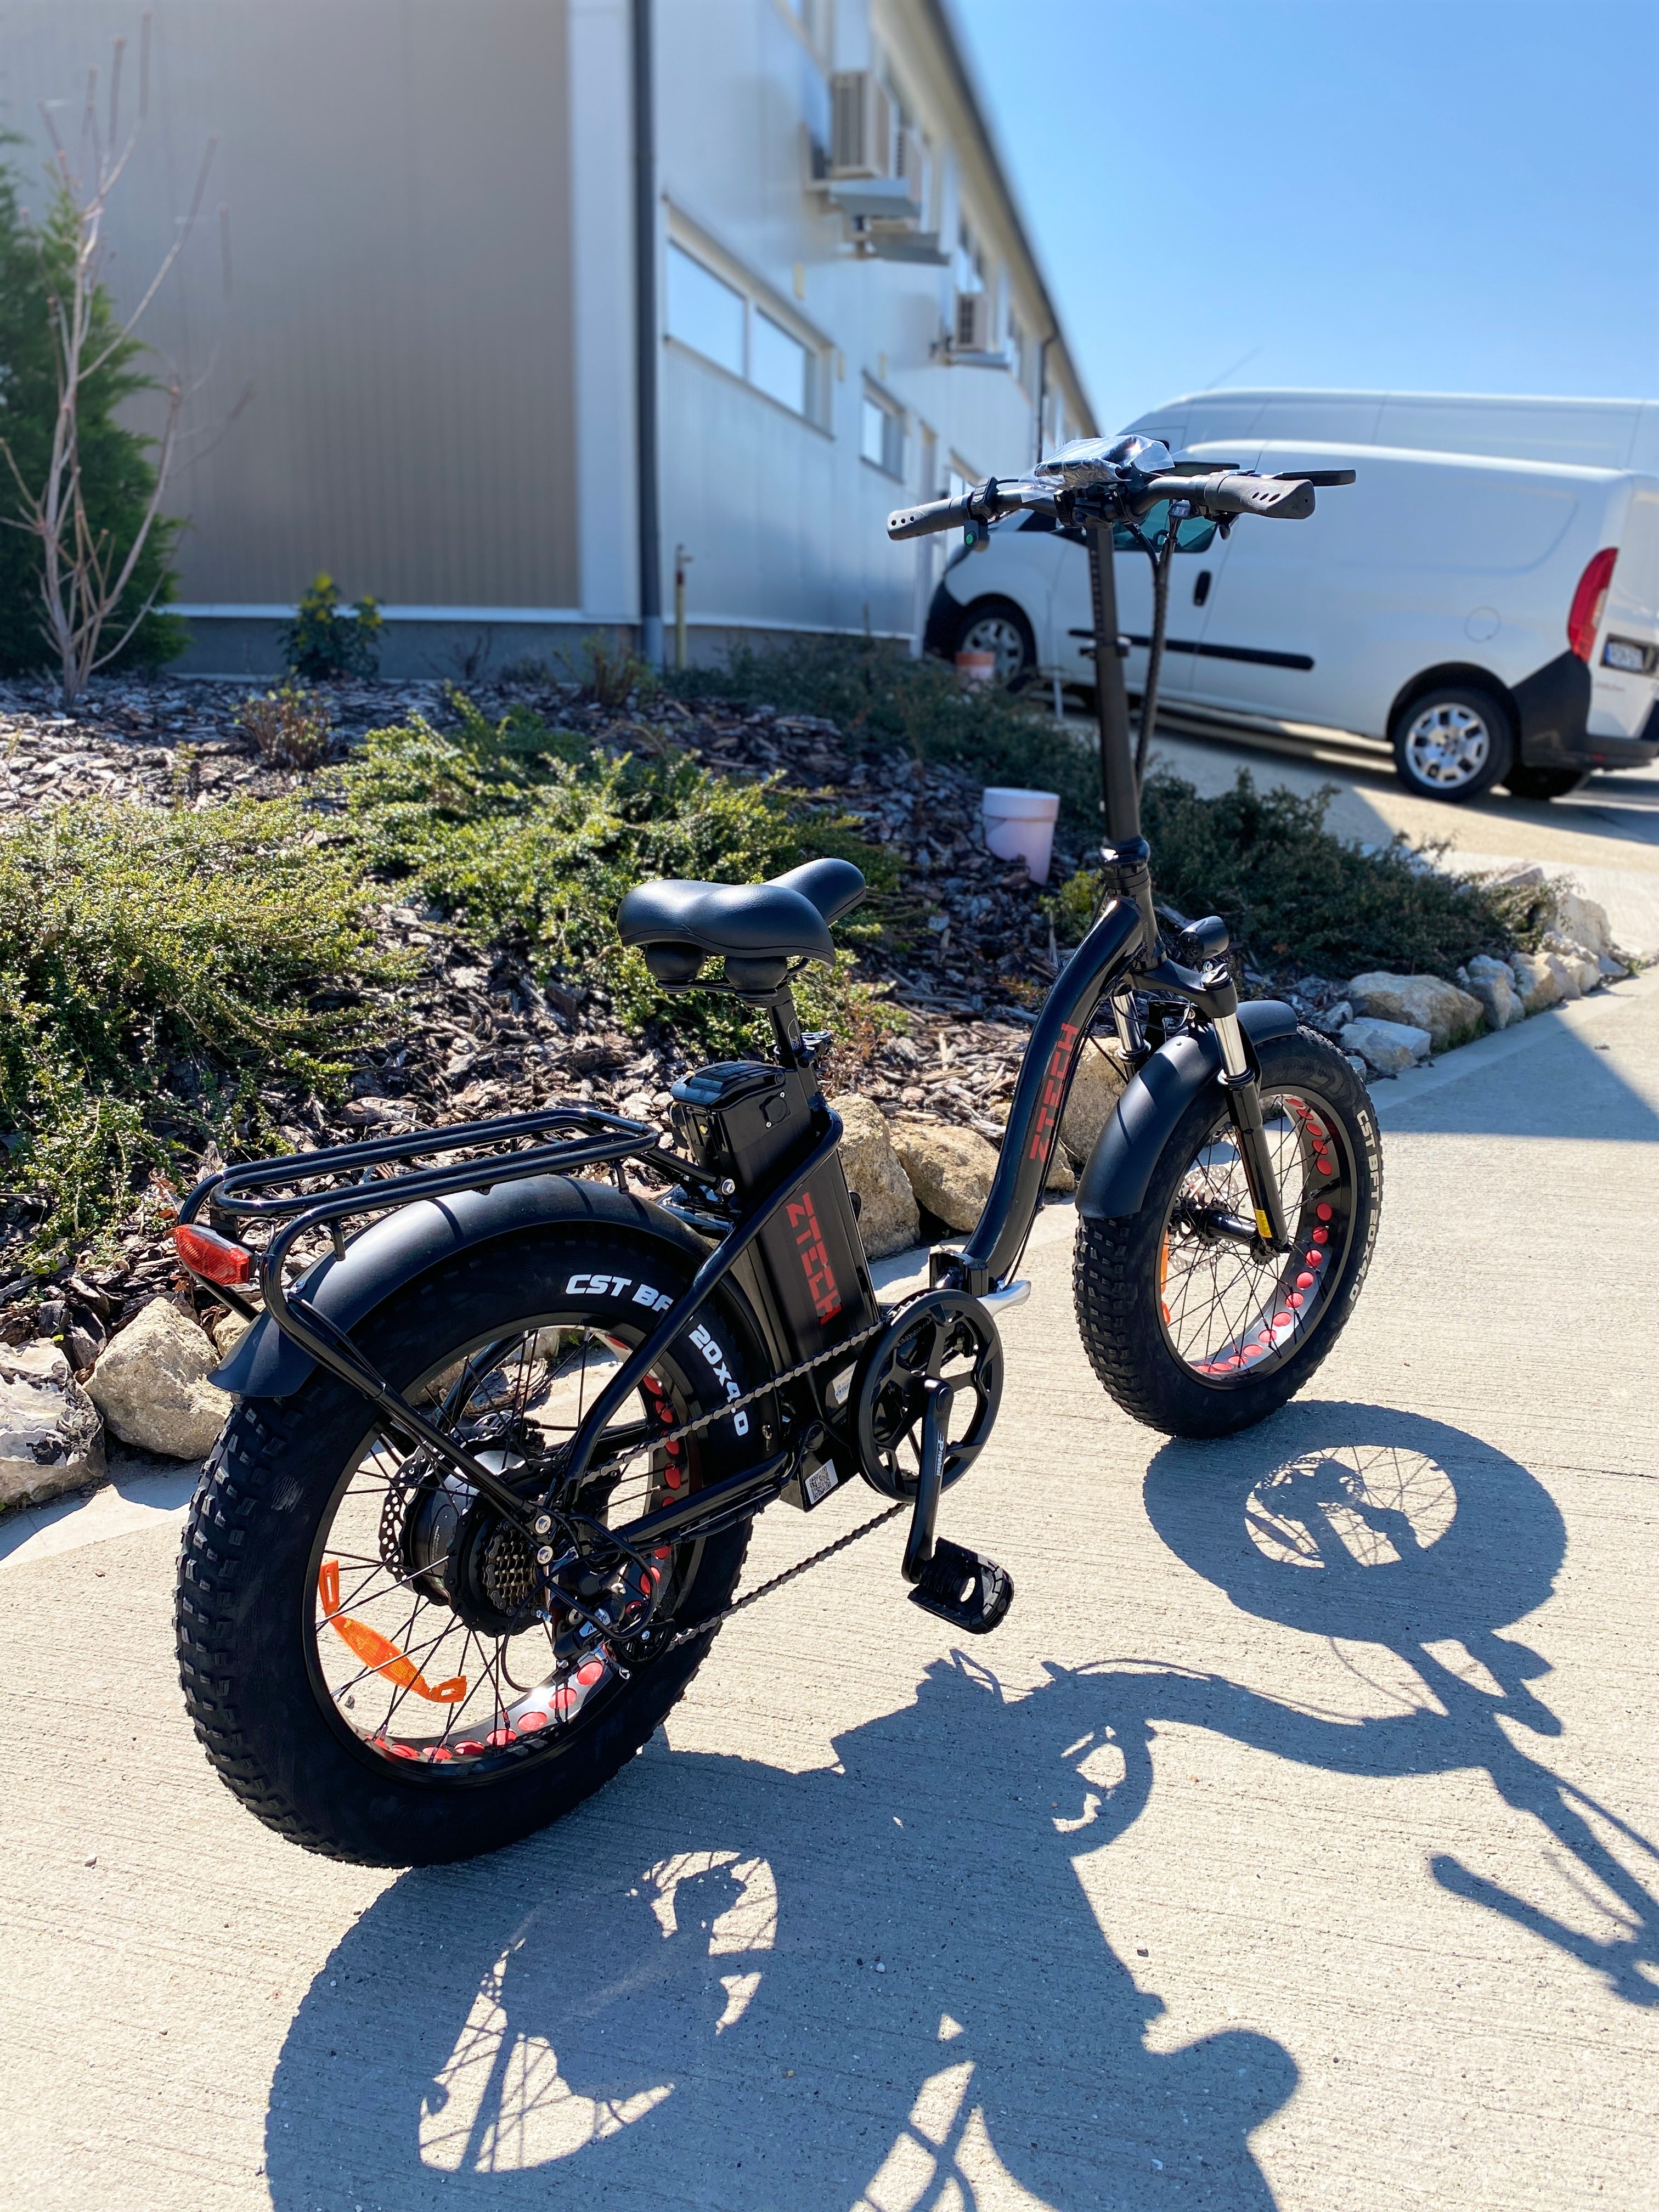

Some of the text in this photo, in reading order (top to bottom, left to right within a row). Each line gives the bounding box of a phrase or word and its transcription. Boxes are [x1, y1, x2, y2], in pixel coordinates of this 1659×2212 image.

[1030, 1023, 1079, 1163] ZTECH
[1357, 1109, 1376, 1149] CST
[1368, 1154, 1380, 1202] BFT
[566, 1274, 633, 1297] CST
[631, 1284, 674, 1312] BF
[786, 1192, 843, 1325] ZTECH
[935, 1430, 944, 1476] Prowheel
